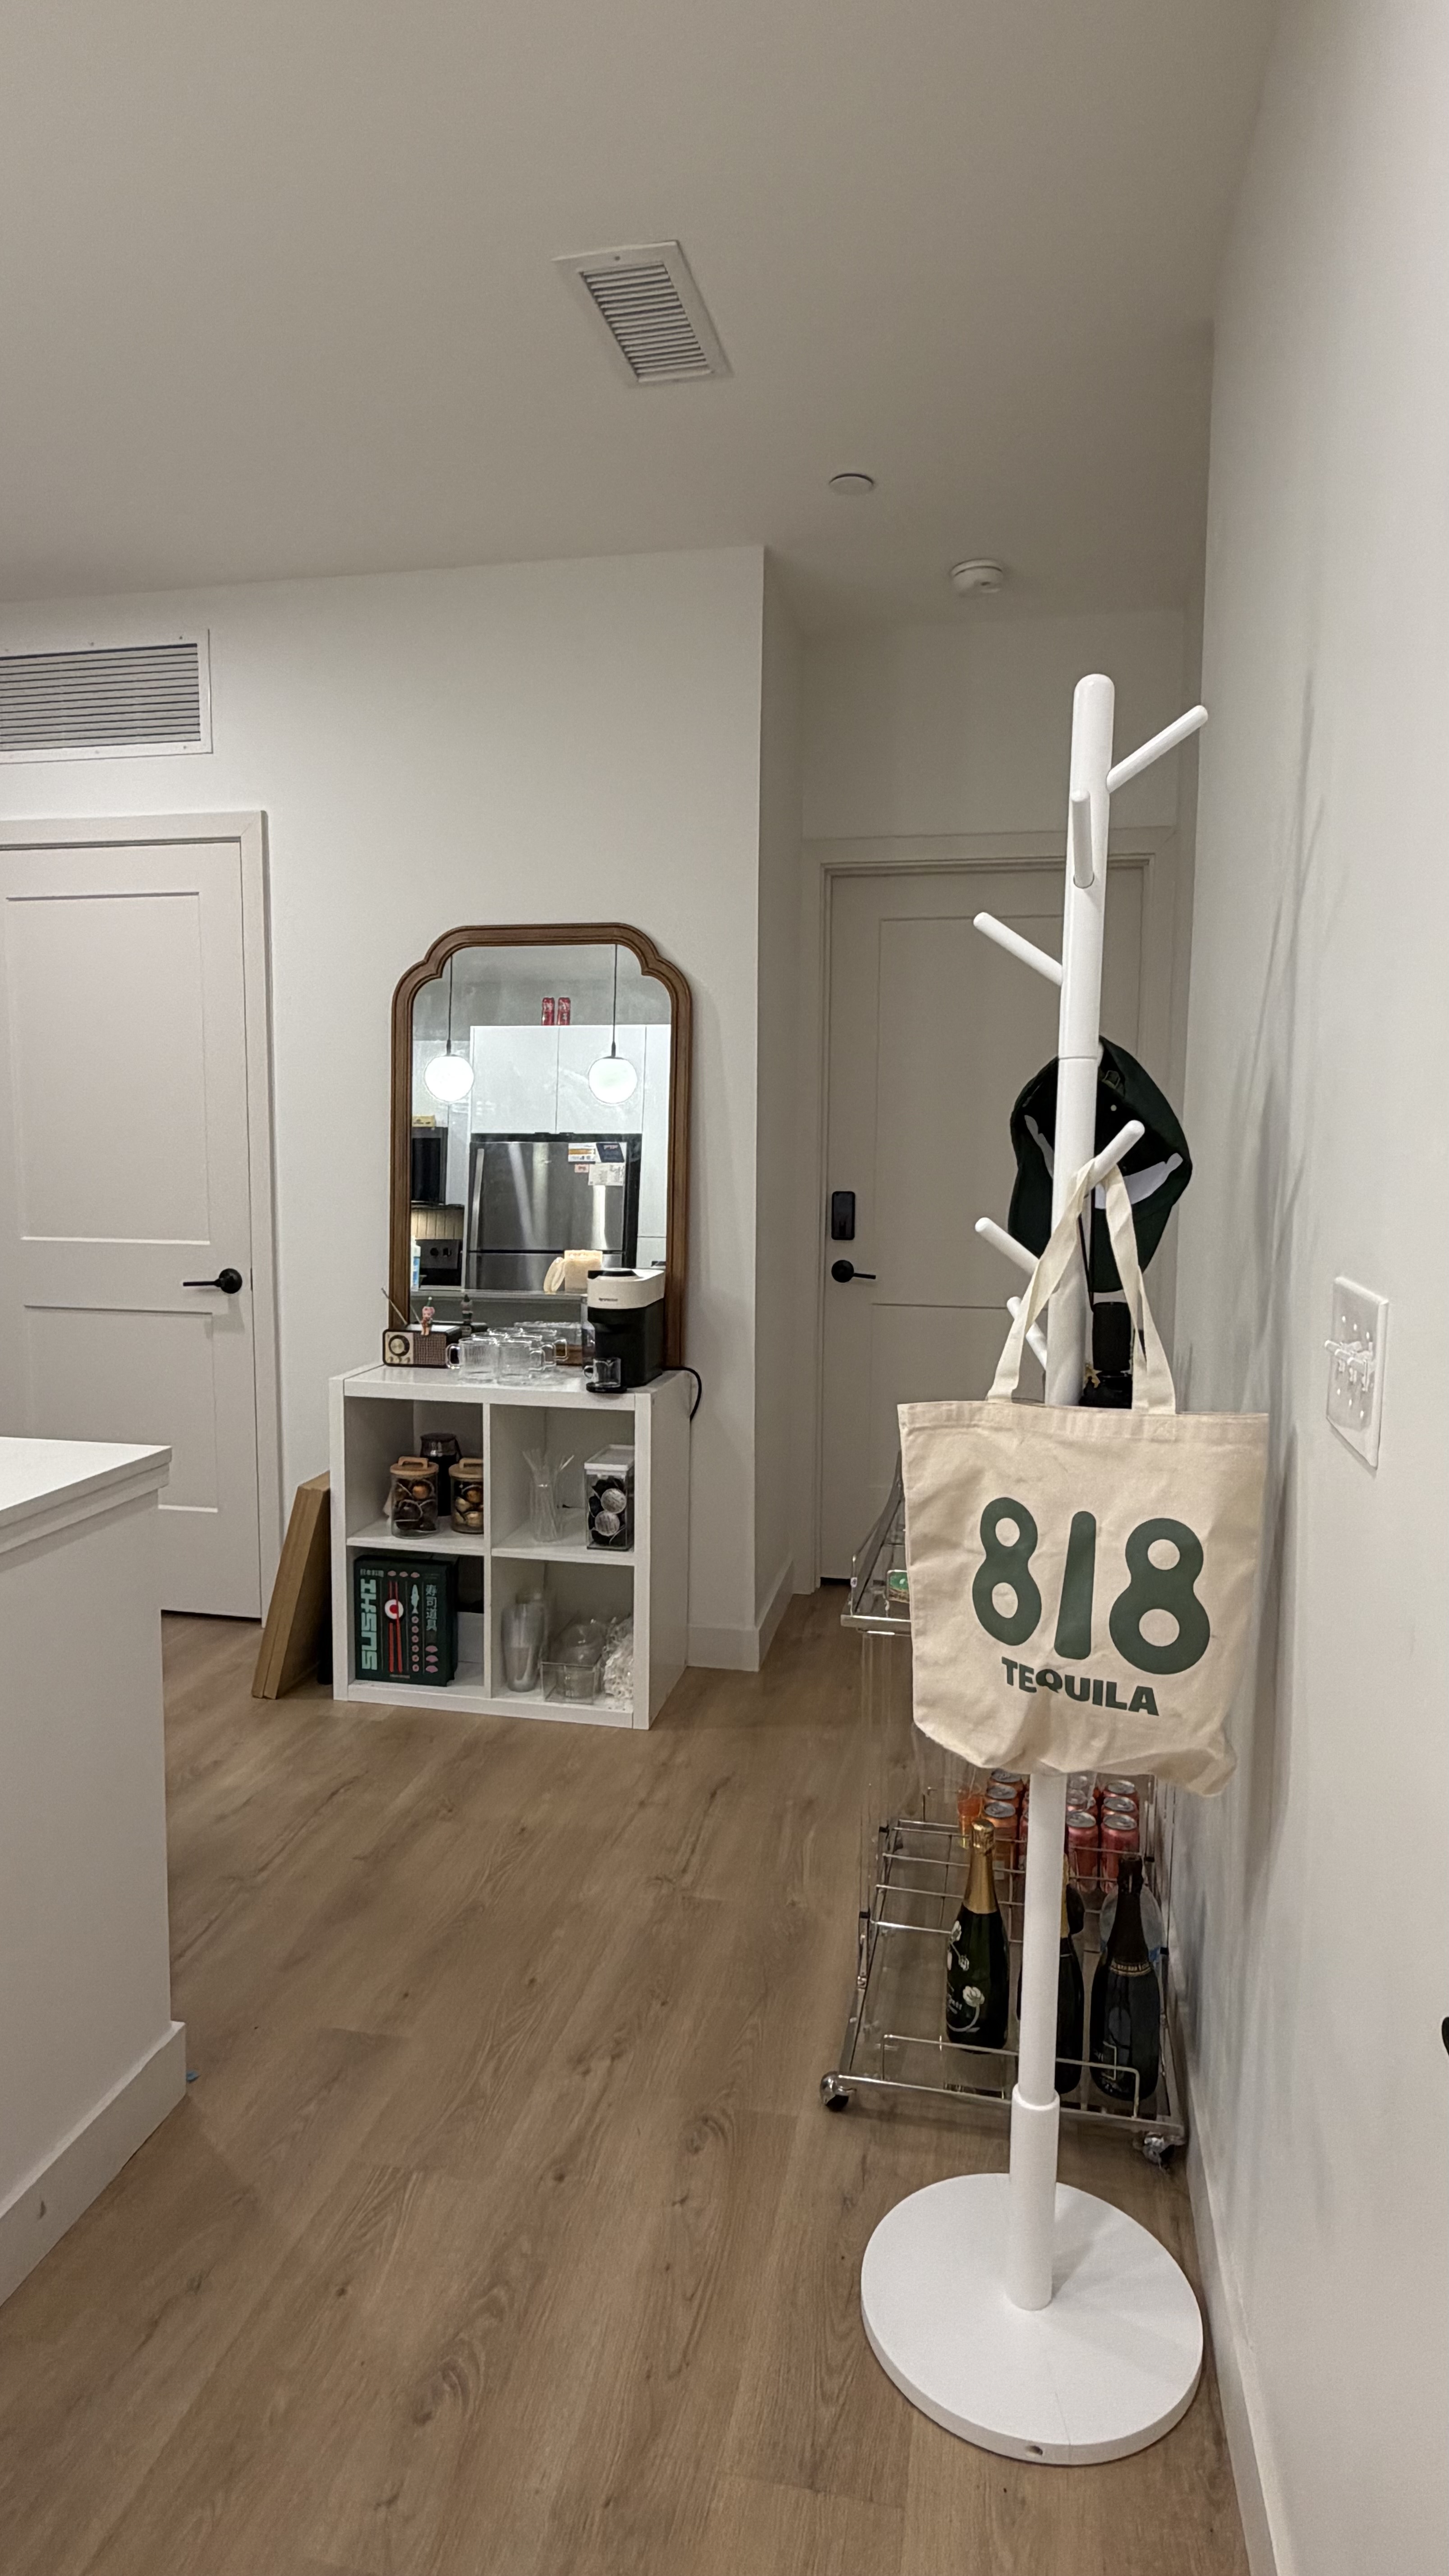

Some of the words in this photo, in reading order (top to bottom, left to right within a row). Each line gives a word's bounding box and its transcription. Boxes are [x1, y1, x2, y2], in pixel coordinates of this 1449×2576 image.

[361, 1579, 377, 1670] SUSHI
[972, 1497, 1210, 1674] 818
[1001, 1656, 1159, 1716] TEQUILA
